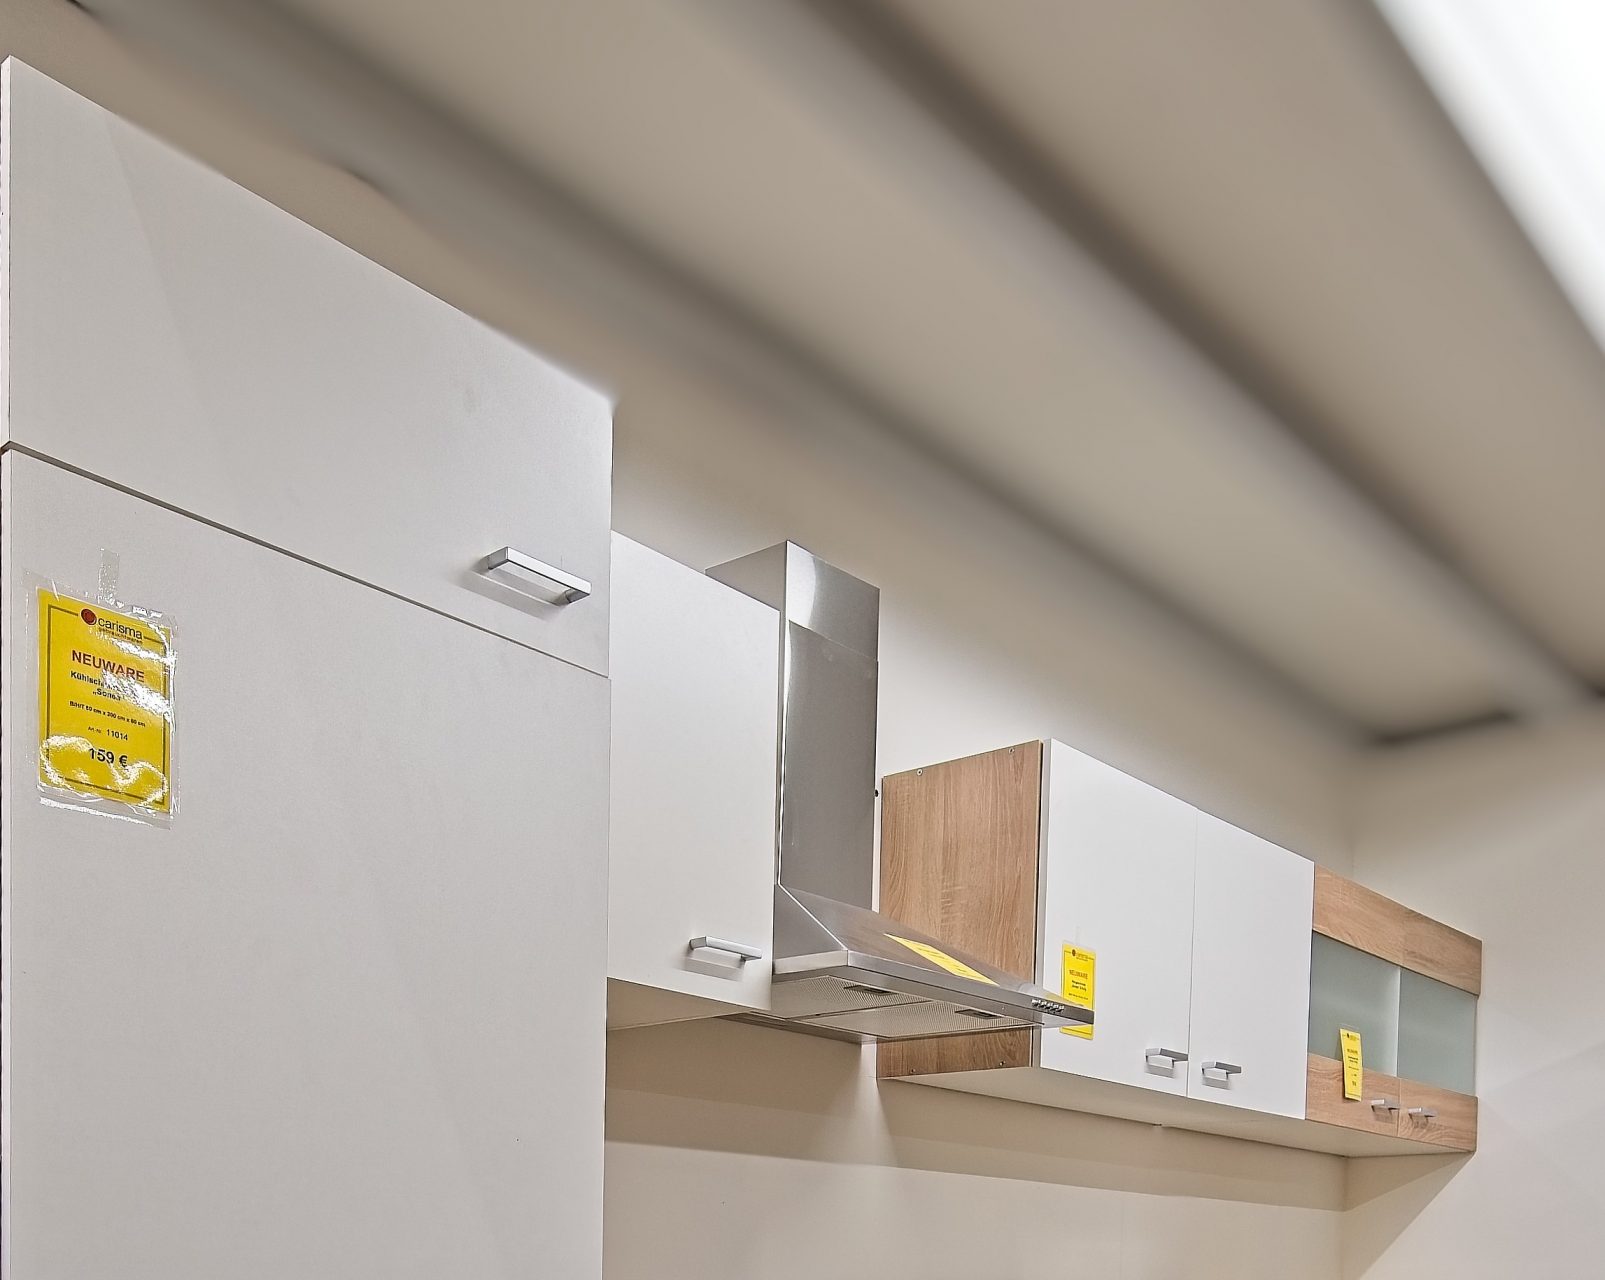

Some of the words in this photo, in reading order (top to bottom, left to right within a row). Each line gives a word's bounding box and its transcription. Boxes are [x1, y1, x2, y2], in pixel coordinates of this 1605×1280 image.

[98, 617, 143, 640] carisma
[72, 649, 145, 683] NEUWARE
[106, 728, 129, 741] 11014
[88, 747, 115, 765] 159
[119, 755, 128, 768] €
